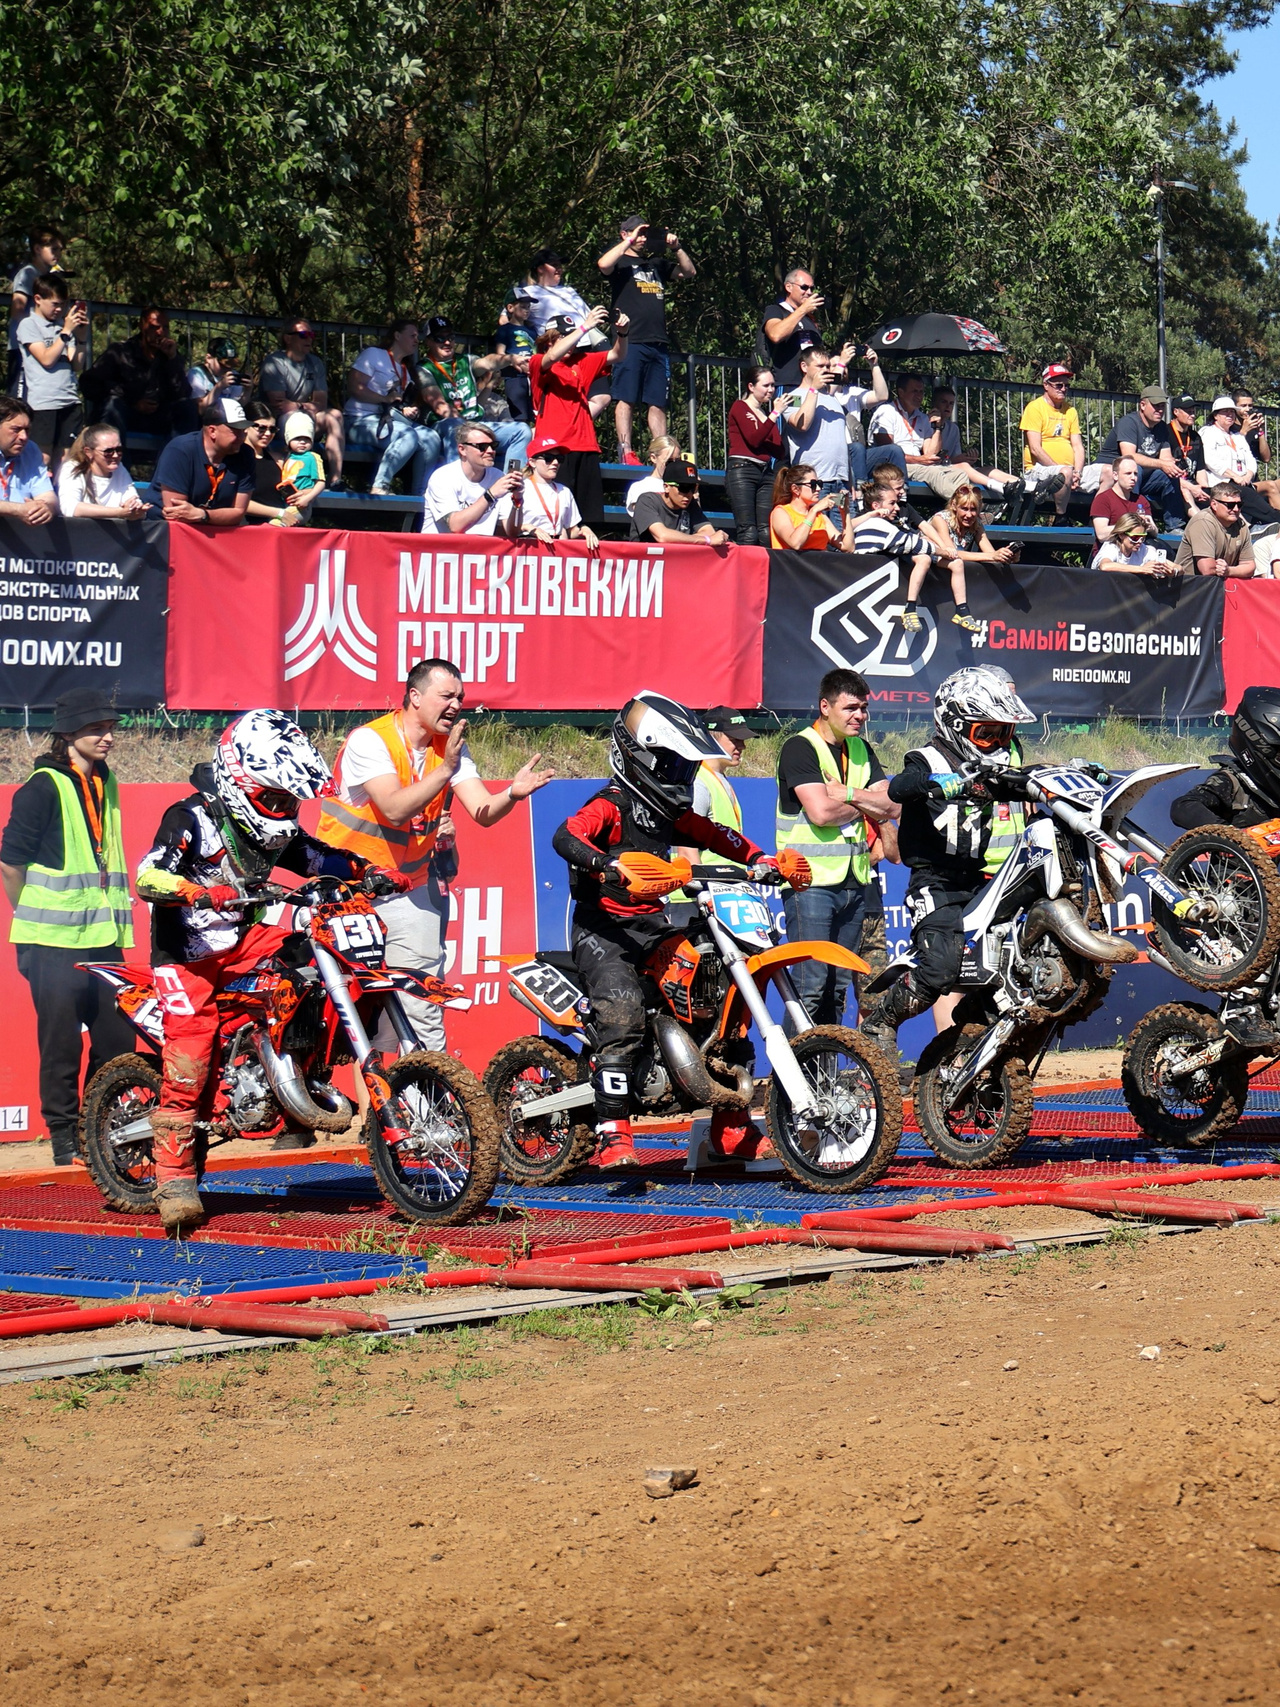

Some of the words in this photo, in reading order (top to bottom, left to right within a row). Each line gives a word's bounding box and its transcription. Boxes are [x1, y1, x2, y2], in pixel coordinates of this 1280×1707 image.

[9, 558, 124, 579] МОТОКРОССА,
[0, 581, 140, 600] ЭКСТРЕМАЛЬНЫХ
[398, 547, 665, 618] МОСКОВСКИЙ
[0, 604, 24, 620] ОВ
[27, 605, 92, 622] СПОРТА
[971, 619, 1201, 656] #СамыйБезопасный
[0, 639, 122, 667] 00MX.RU
[397, 621, 524, 683] СПОРТ
[1052, 668, 1131, 684] RIDE100MX.RU
[866, 690, 931, 703] METS
[1053, 774, 1095, 791] 111
[1141, 874, 1176, 903] Mitas
[720, 900, 771, 926] 730
[328, 914, 384, 951] 131
[510, 960, 580, 1013] 730
[133, 998, 165, 1033] 13
[2, 1107, 24, 1130] 14
